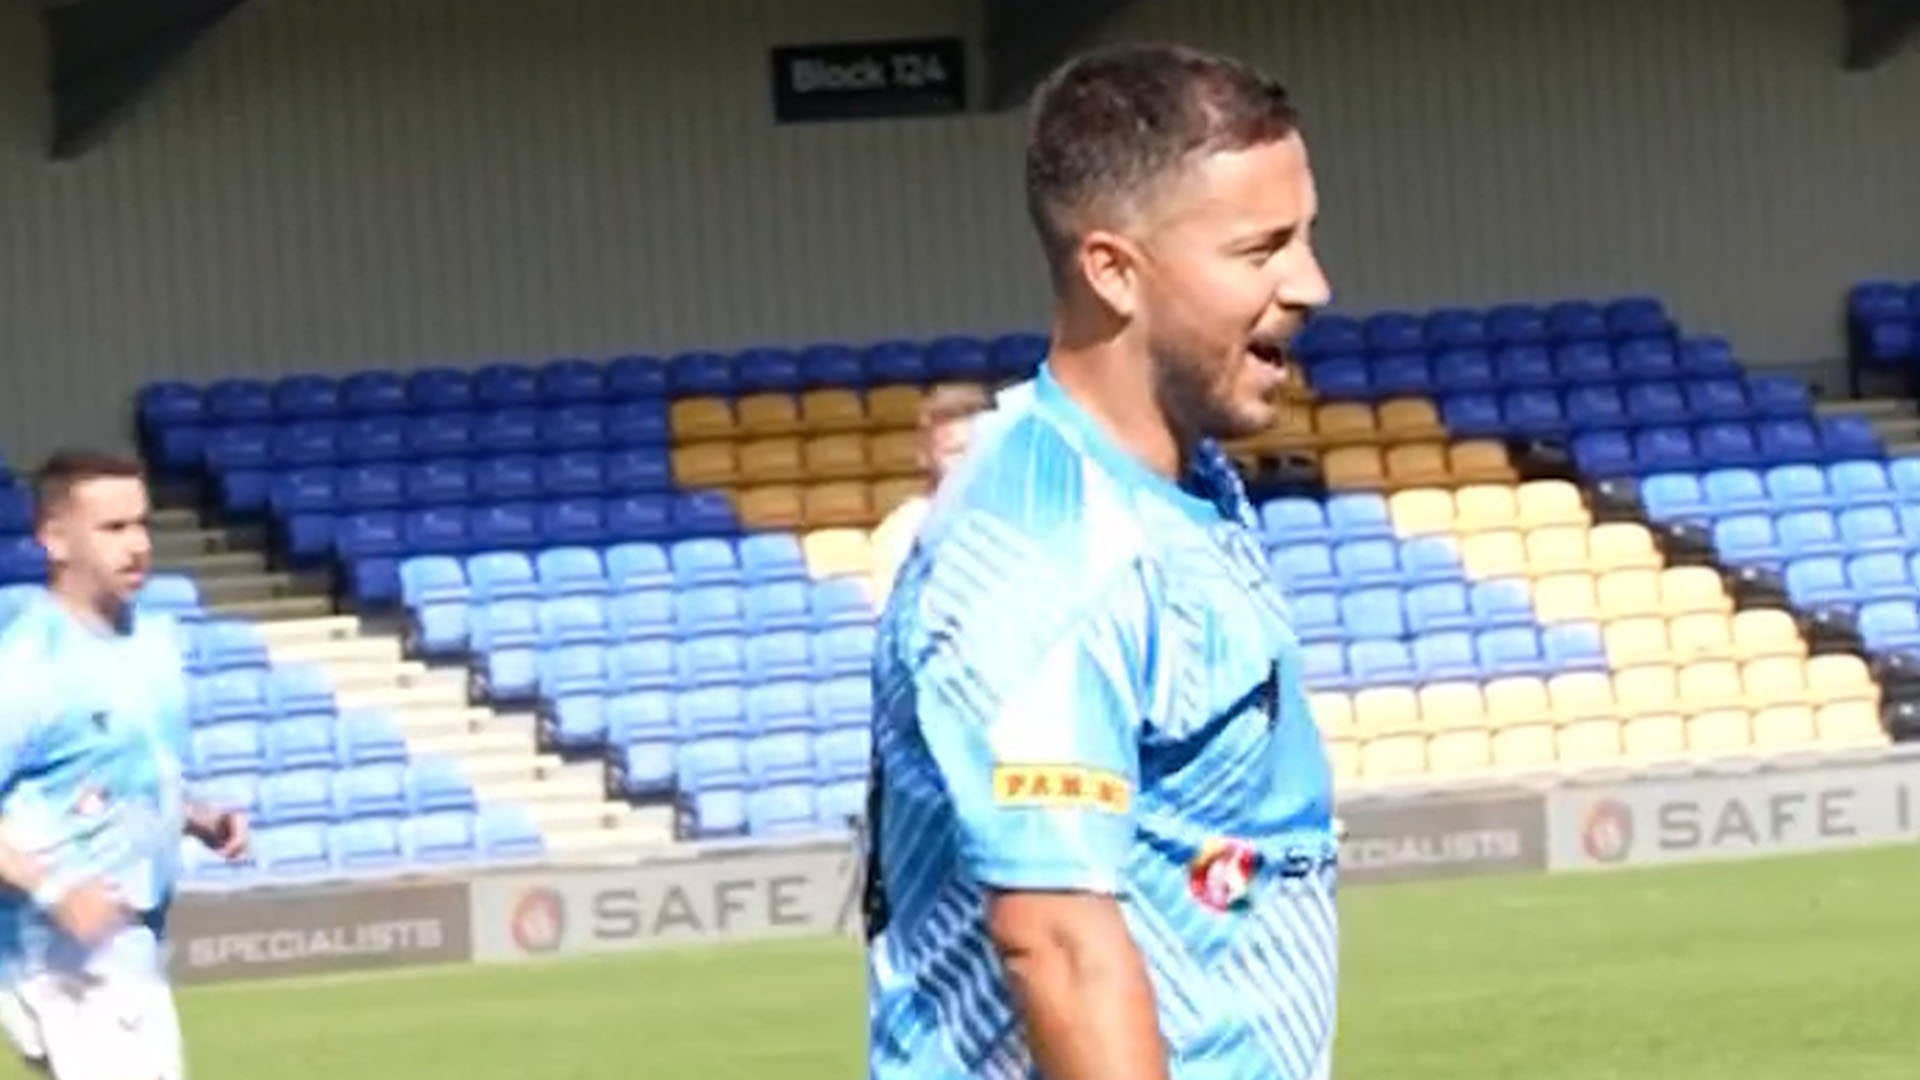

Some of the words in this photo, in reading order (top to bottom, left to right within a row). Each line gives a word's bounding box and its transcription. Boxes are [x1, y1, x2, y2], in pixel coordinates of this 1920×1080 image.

[792, 56, 884, 92] Block
[891, 53, 947, 86] 124
[1658, 787, 1860, 849] SAFE
[593, 875, 813, 939] SAFE
[188, 919, 443, 966] SPECIALISTS
